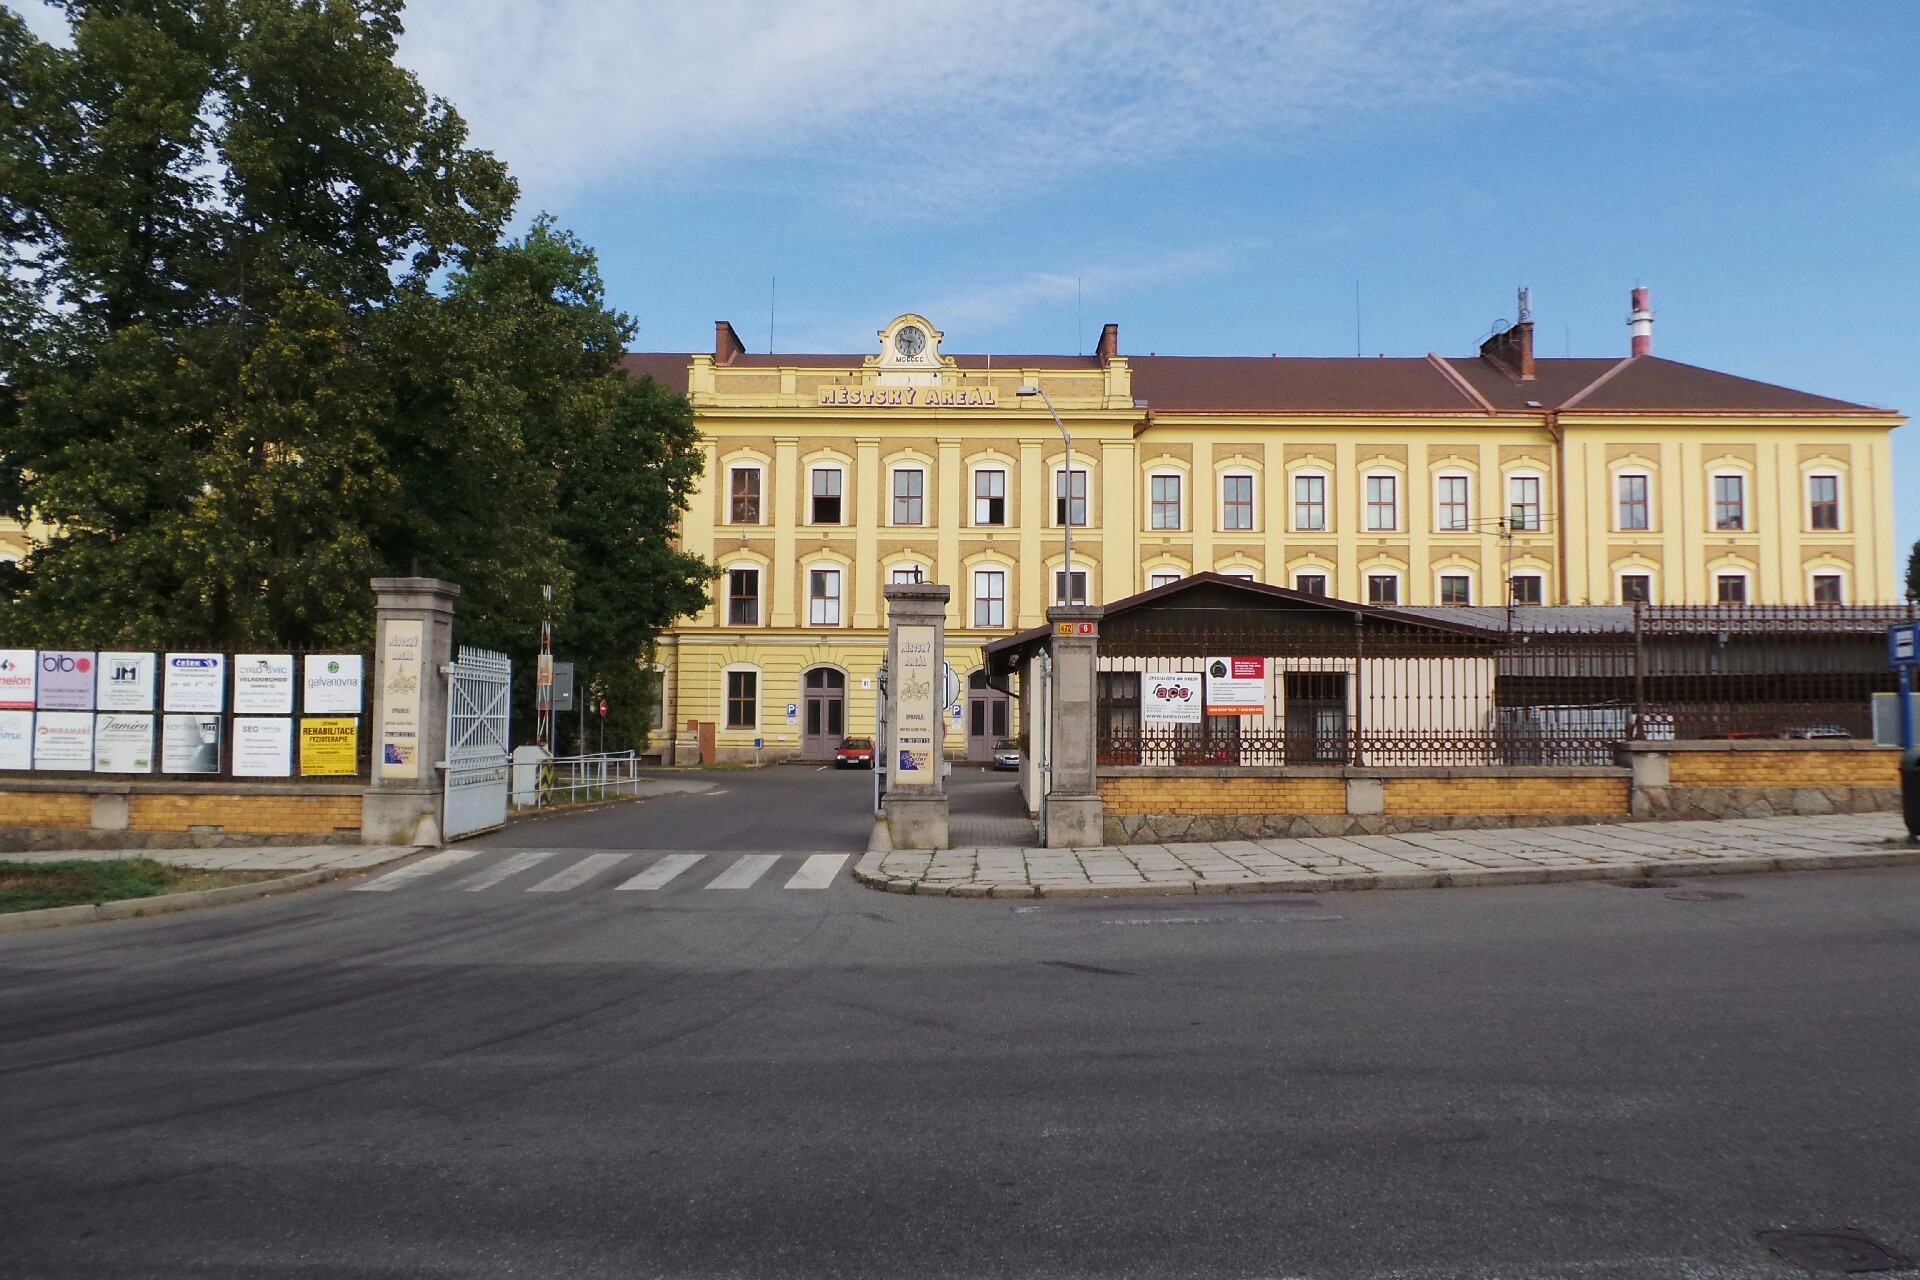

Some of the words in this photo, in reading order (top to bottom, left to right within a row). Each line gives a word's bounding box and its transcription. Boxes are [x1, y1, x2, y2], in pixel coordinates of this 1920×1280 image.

[820, 386, 917, 405] MĚSTSKÝ
[925, 387, 996, 405] AREÁL
[1083, 624, 1088, 632] 6
[175, 659, 200, 667] ČEŠEK
[308, 677, 357, 688] galvanovna
[1156, 687, 1189, 698] ace
